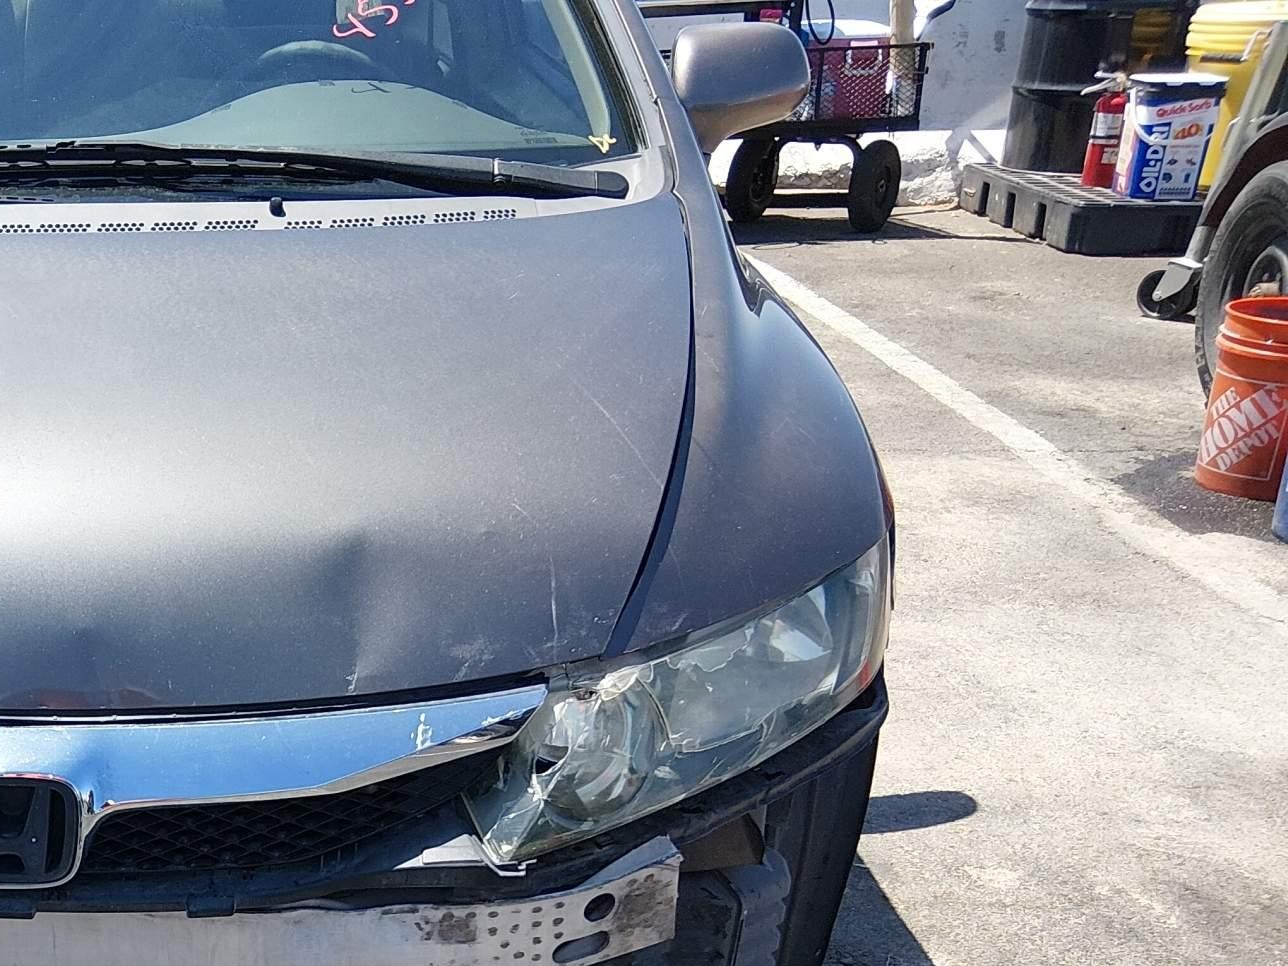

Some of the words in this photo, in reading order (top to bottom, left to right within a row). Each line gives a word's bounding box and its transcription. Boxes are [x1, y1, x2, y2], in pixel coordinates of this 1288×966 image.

[1199, 388, 1284, 465] HOME
[1211, 386, 1241, 421] THE
[1215, 422, 1280, 472] DEPOT
